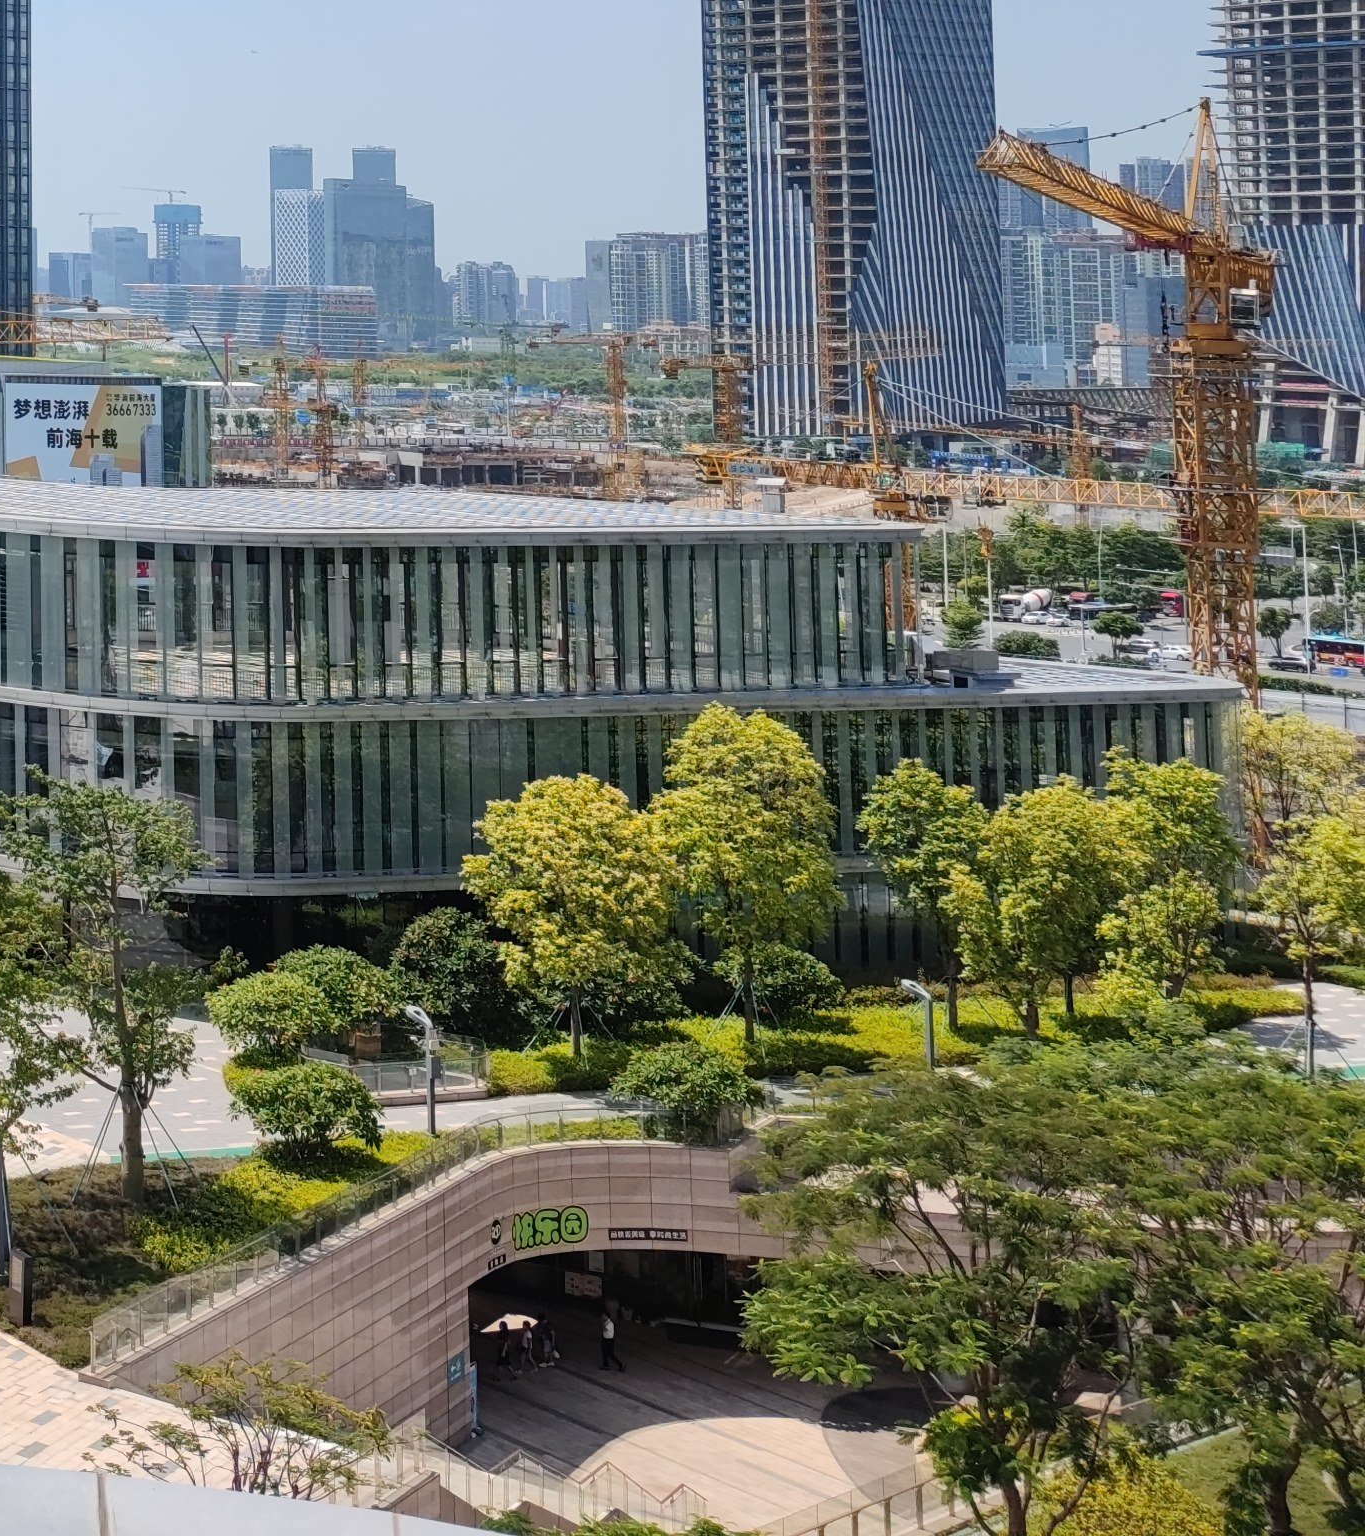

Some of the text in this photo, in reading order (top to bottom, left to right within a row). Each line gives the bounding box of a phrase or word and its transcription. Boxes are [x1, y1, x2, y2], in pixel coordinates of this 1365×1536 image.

[13, 398, 90, 421] 梦想澎湃
[105, 403, 157, 416] 36667333
[46, 427, 118, 449] 前海十载
[511, 1205, 589, 1251] 快乐园
